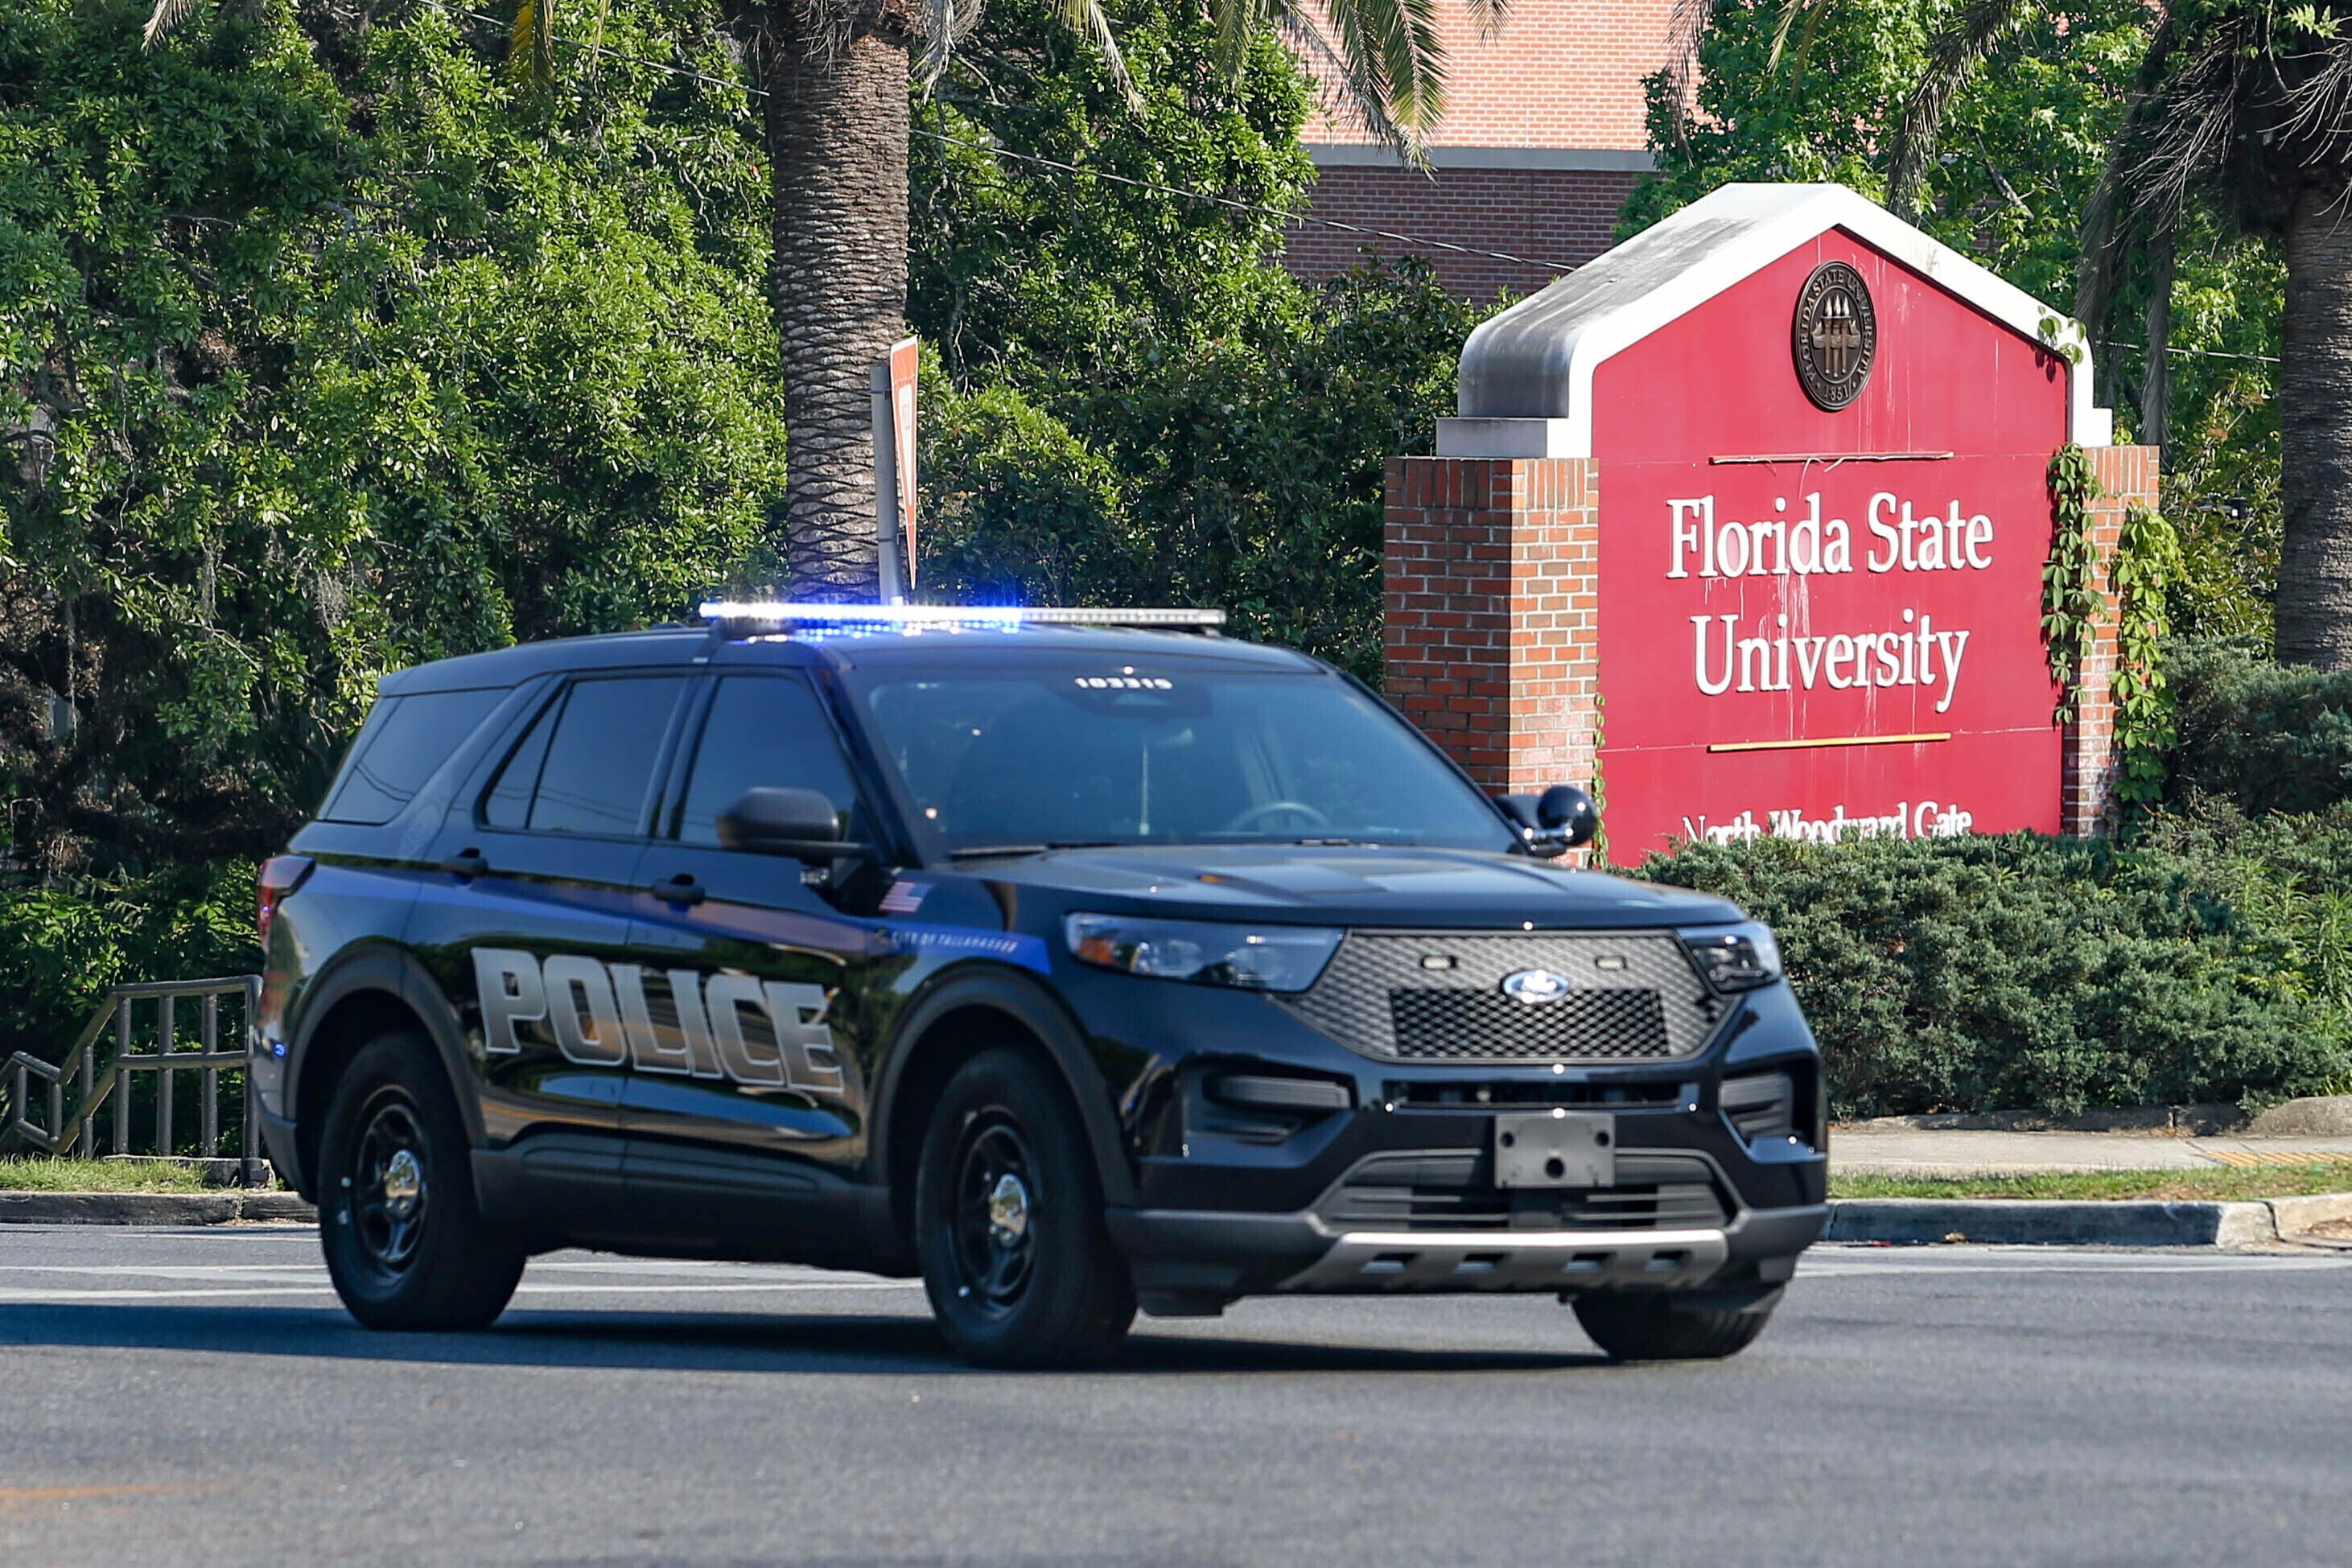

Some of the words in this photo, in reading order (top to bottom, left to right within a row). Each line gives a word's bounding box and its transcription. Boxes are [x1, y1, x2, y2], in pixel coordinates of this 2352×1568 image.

[1801, 296, 1817, 382] FLORIDA
[1812, 270, 1844, 297] STATE
[1847, 273, 1873, 381] UNIVERSITY
[1823, 385, 1849, 401] 1851
[1666, 492, 1852, 578] Florida
[1867, 492, 1994, 573] State
[1690, 608, 1970, 713] University
[1682, 810, 1761, 850] North
[1913, 800, 1973, 841] Gate
[471, 946, 845, 1094] POLICE
